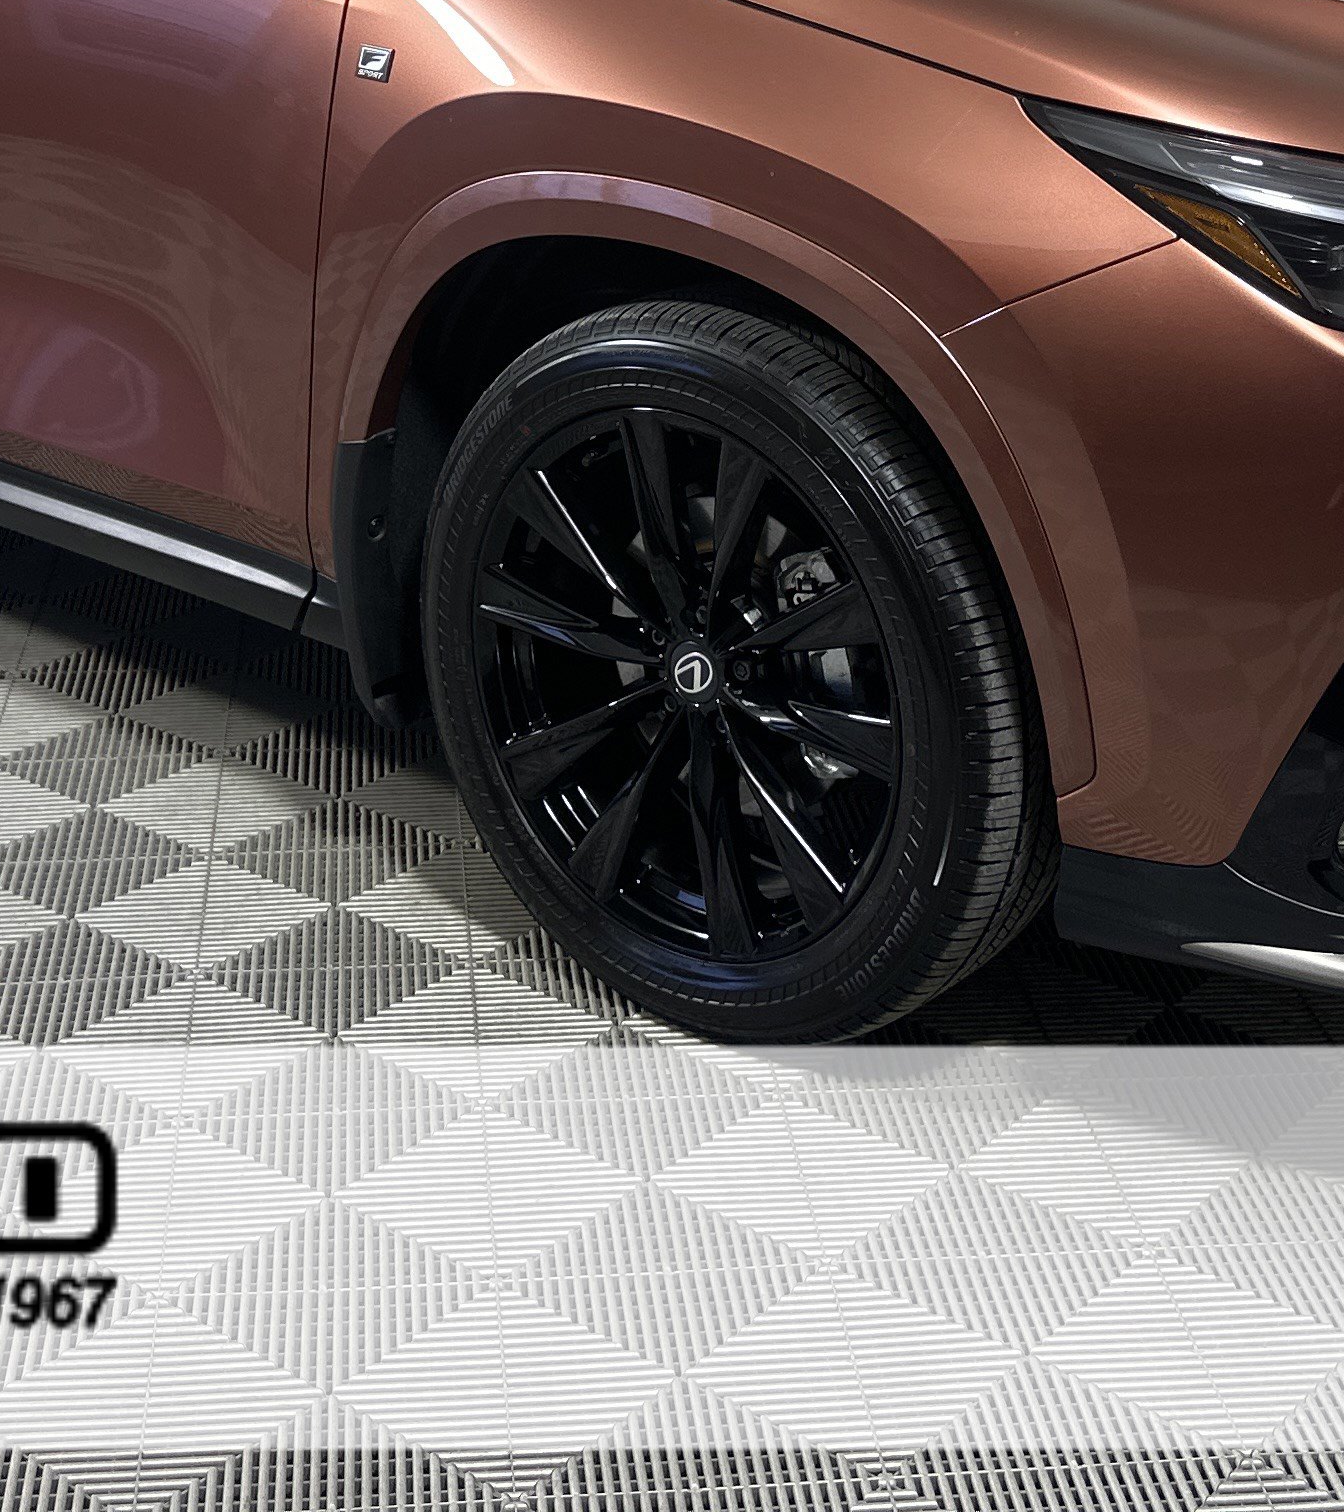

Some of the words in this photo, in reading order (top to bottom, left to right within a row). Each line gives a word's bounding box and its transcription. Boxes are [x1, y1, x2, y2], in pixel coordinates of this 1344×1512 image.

[359, 47, 389, 71] F
[357, 68, 384, 80] SPORT
[442, 392, 513, 504] BRIDGESTONE
